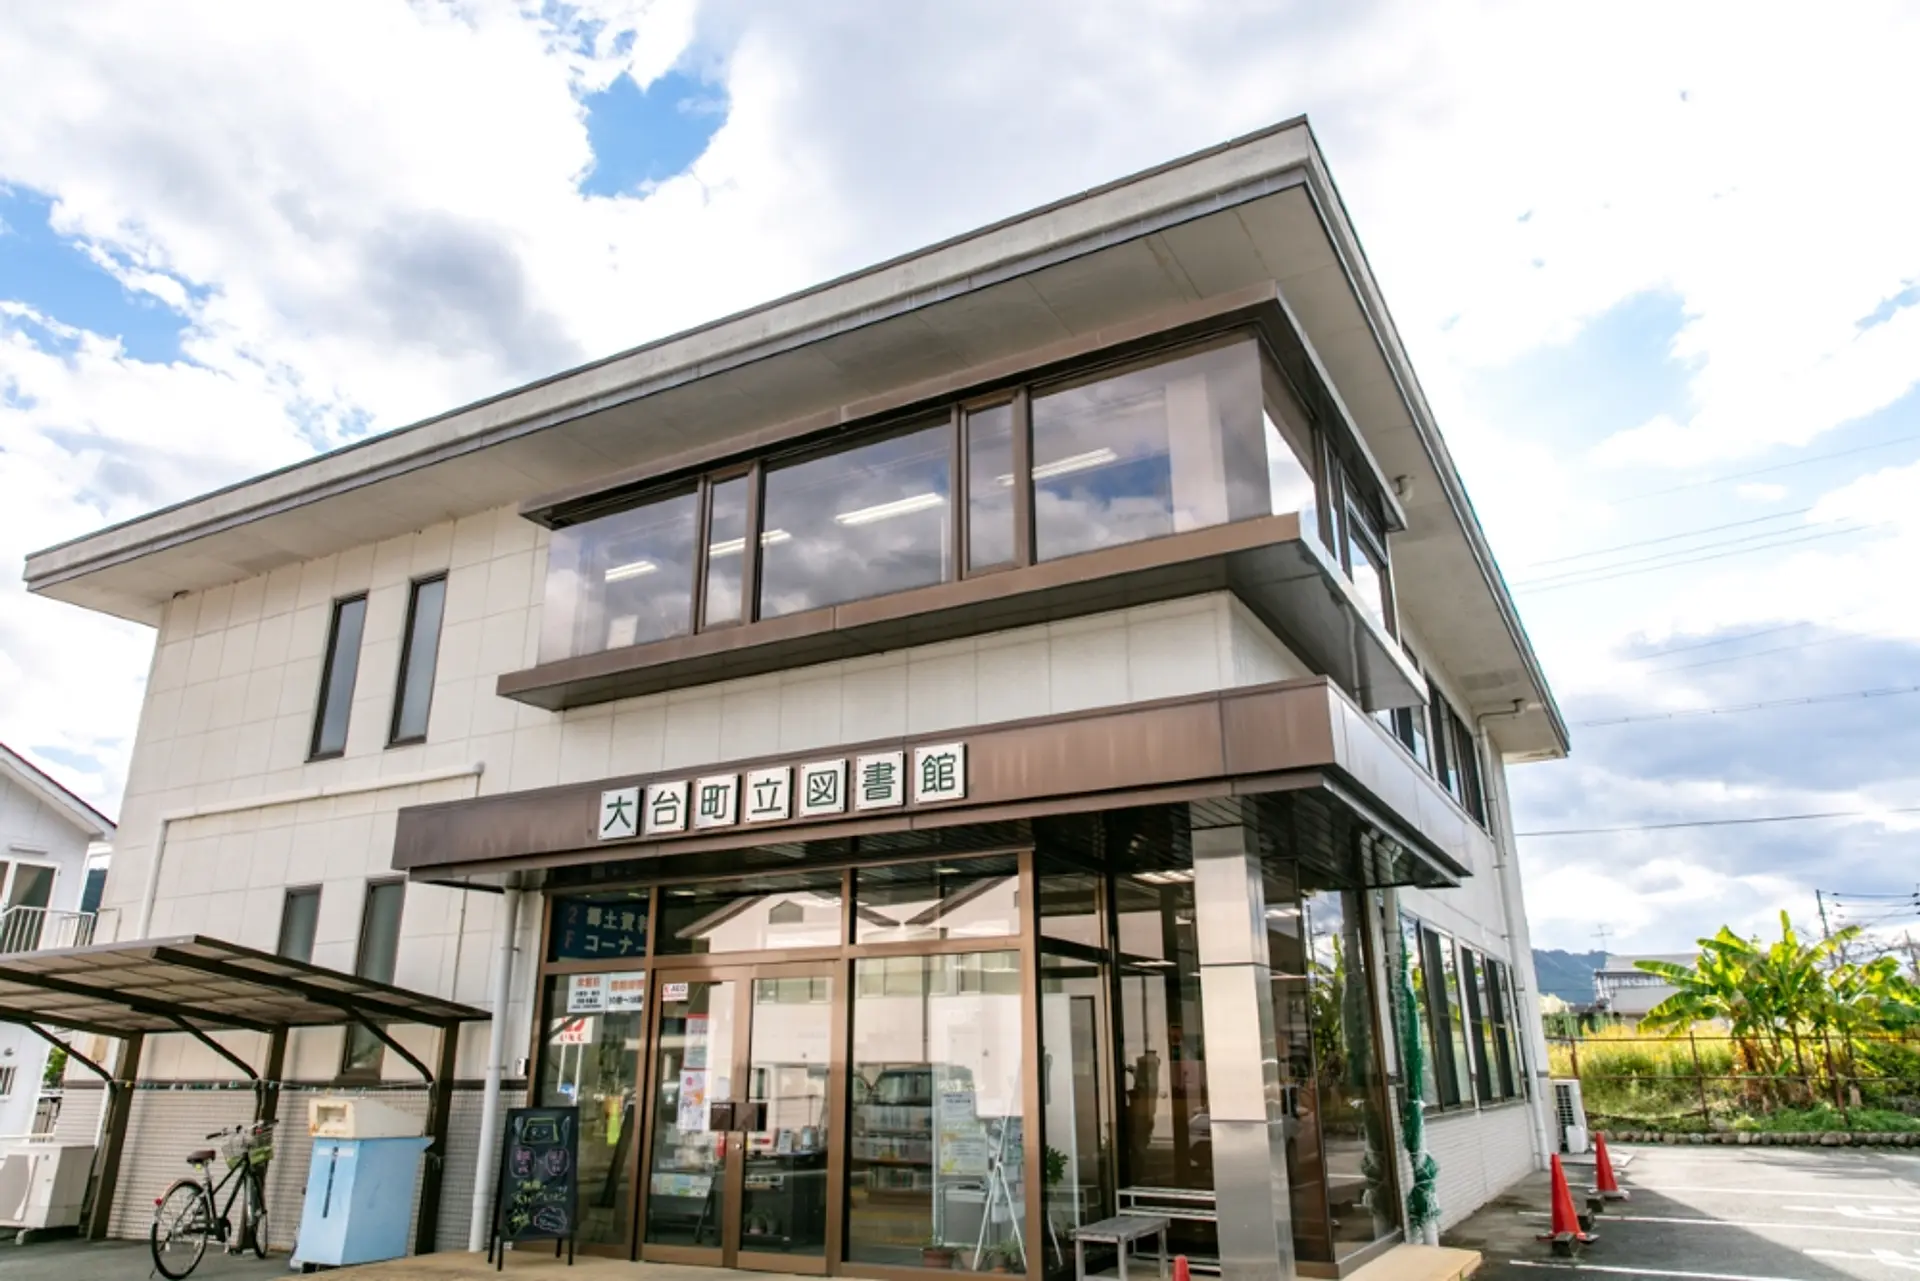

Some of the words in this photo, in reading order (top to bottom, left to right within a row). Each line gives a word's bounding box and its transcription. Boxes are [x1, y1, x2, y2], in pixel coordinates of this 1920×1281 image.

[604, 752, 956, 831] 大台町立図書館
